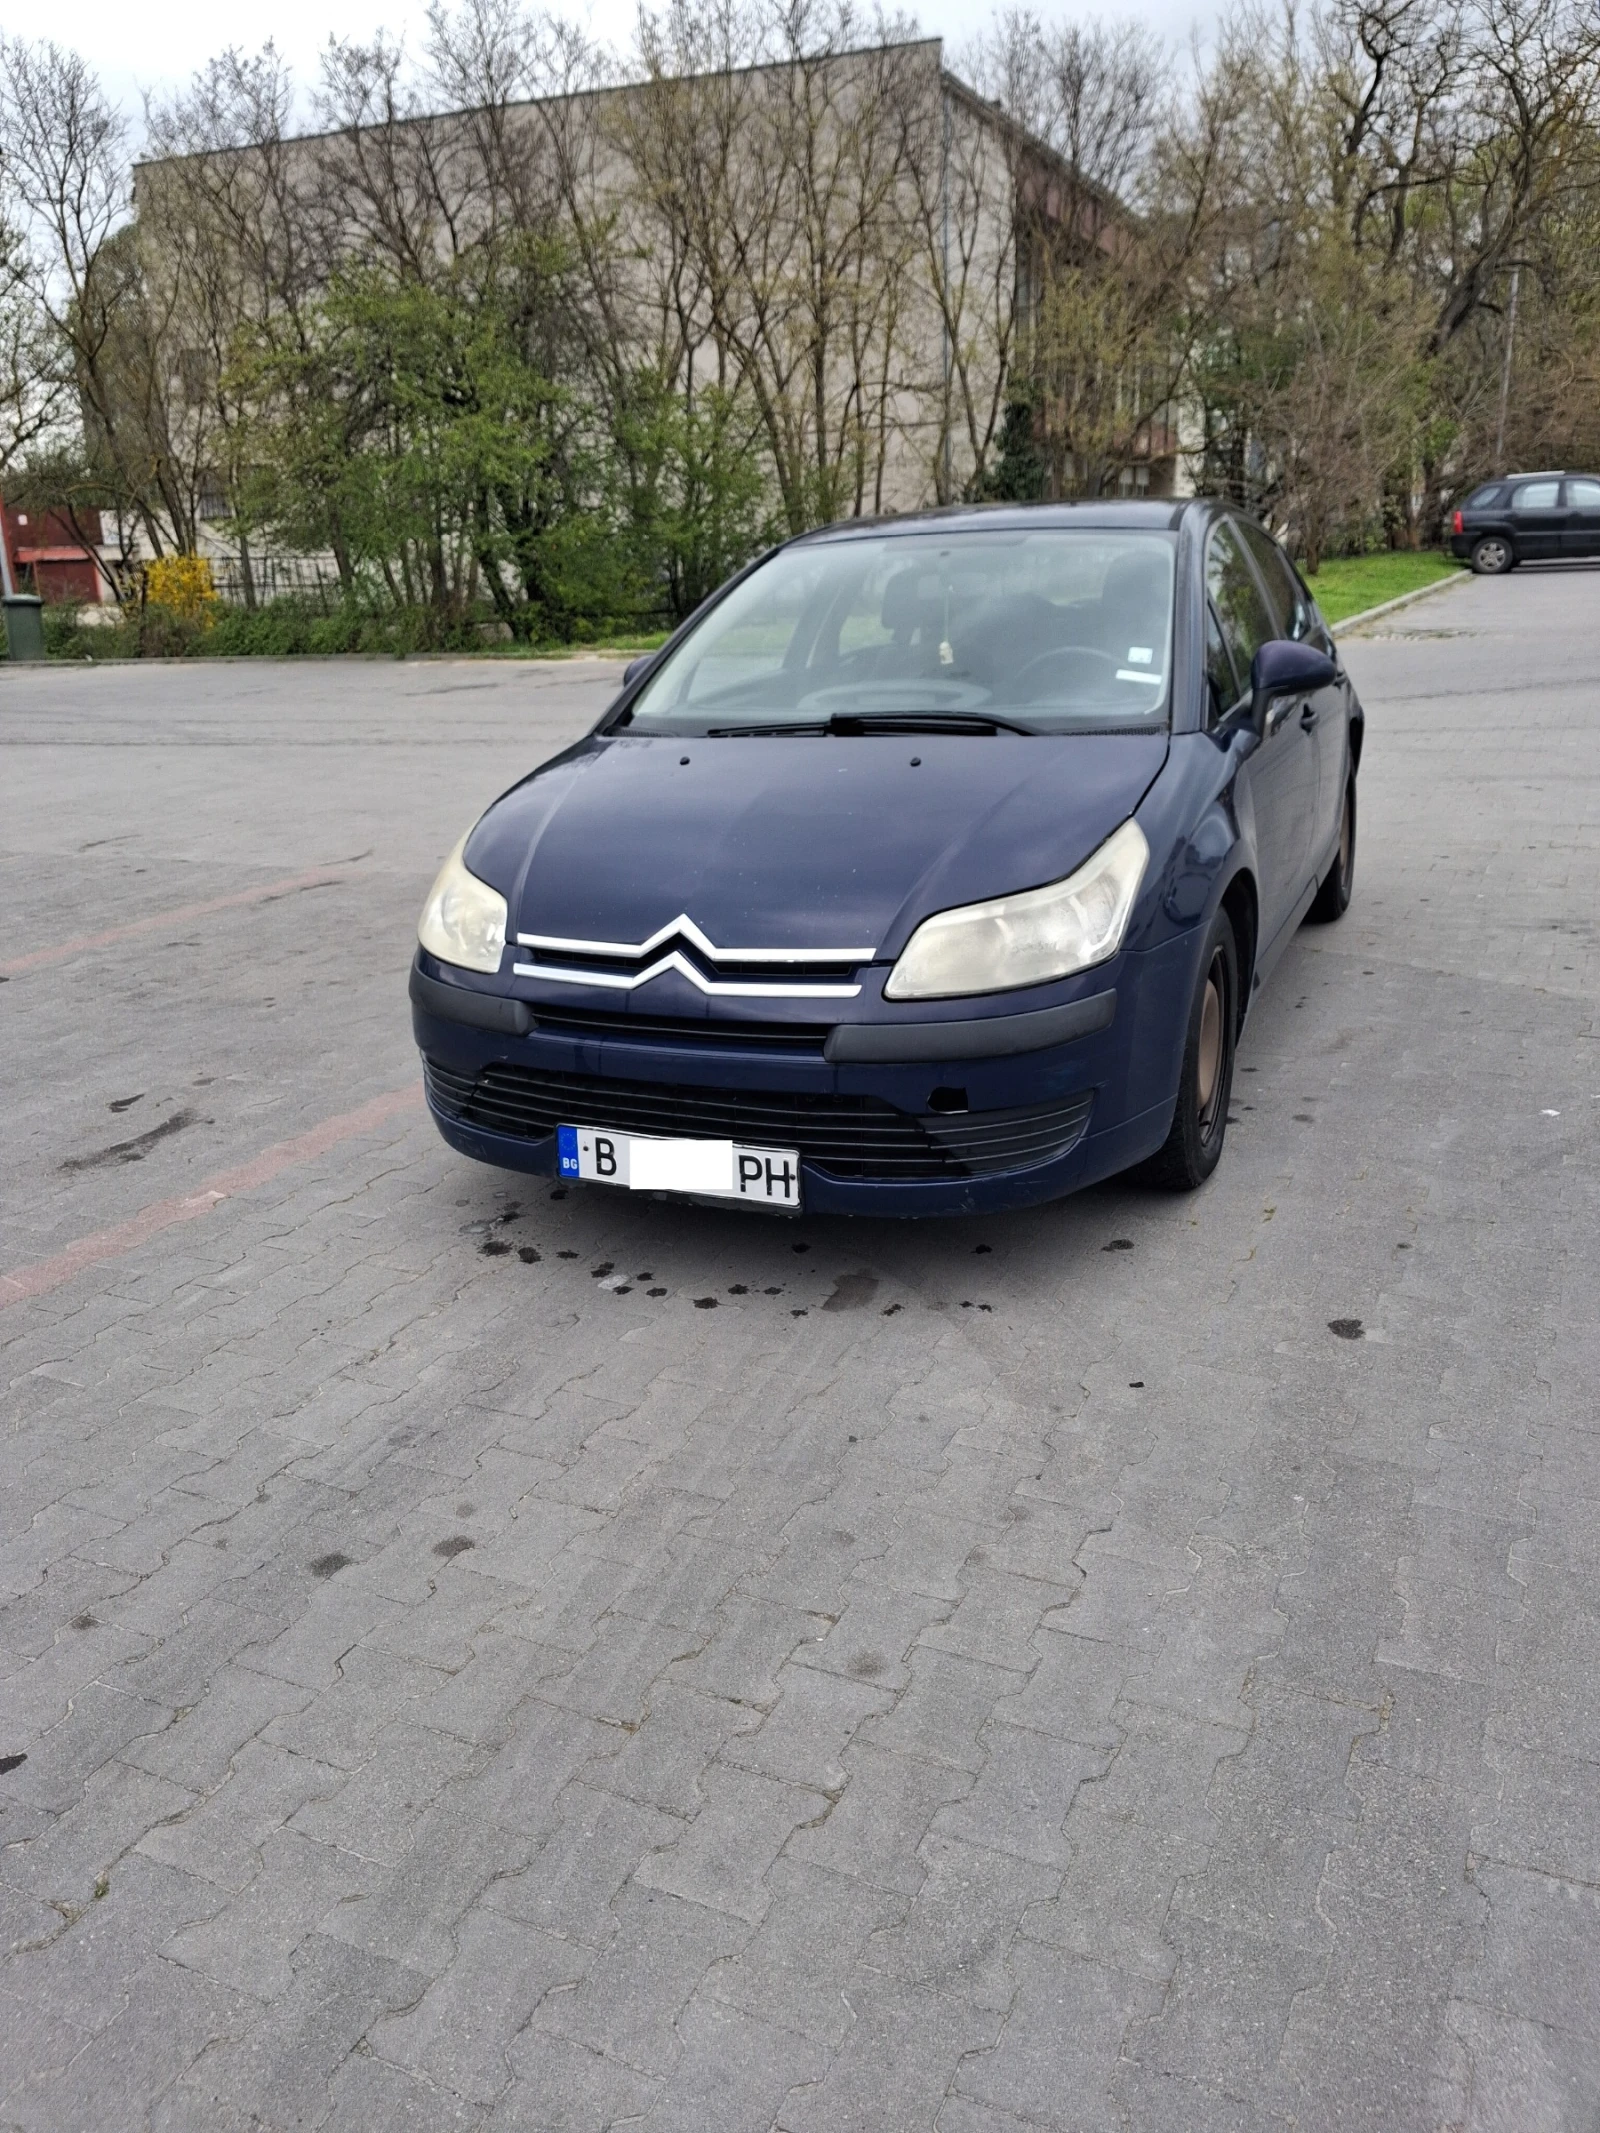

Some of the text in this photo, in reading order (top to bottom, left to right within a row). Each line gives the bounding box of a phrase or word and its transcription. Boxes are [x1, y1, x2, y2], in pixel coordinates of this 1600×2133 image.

[562, 1157, 578, 1170] BG
[595, 1137, 790, 1198] B PH
